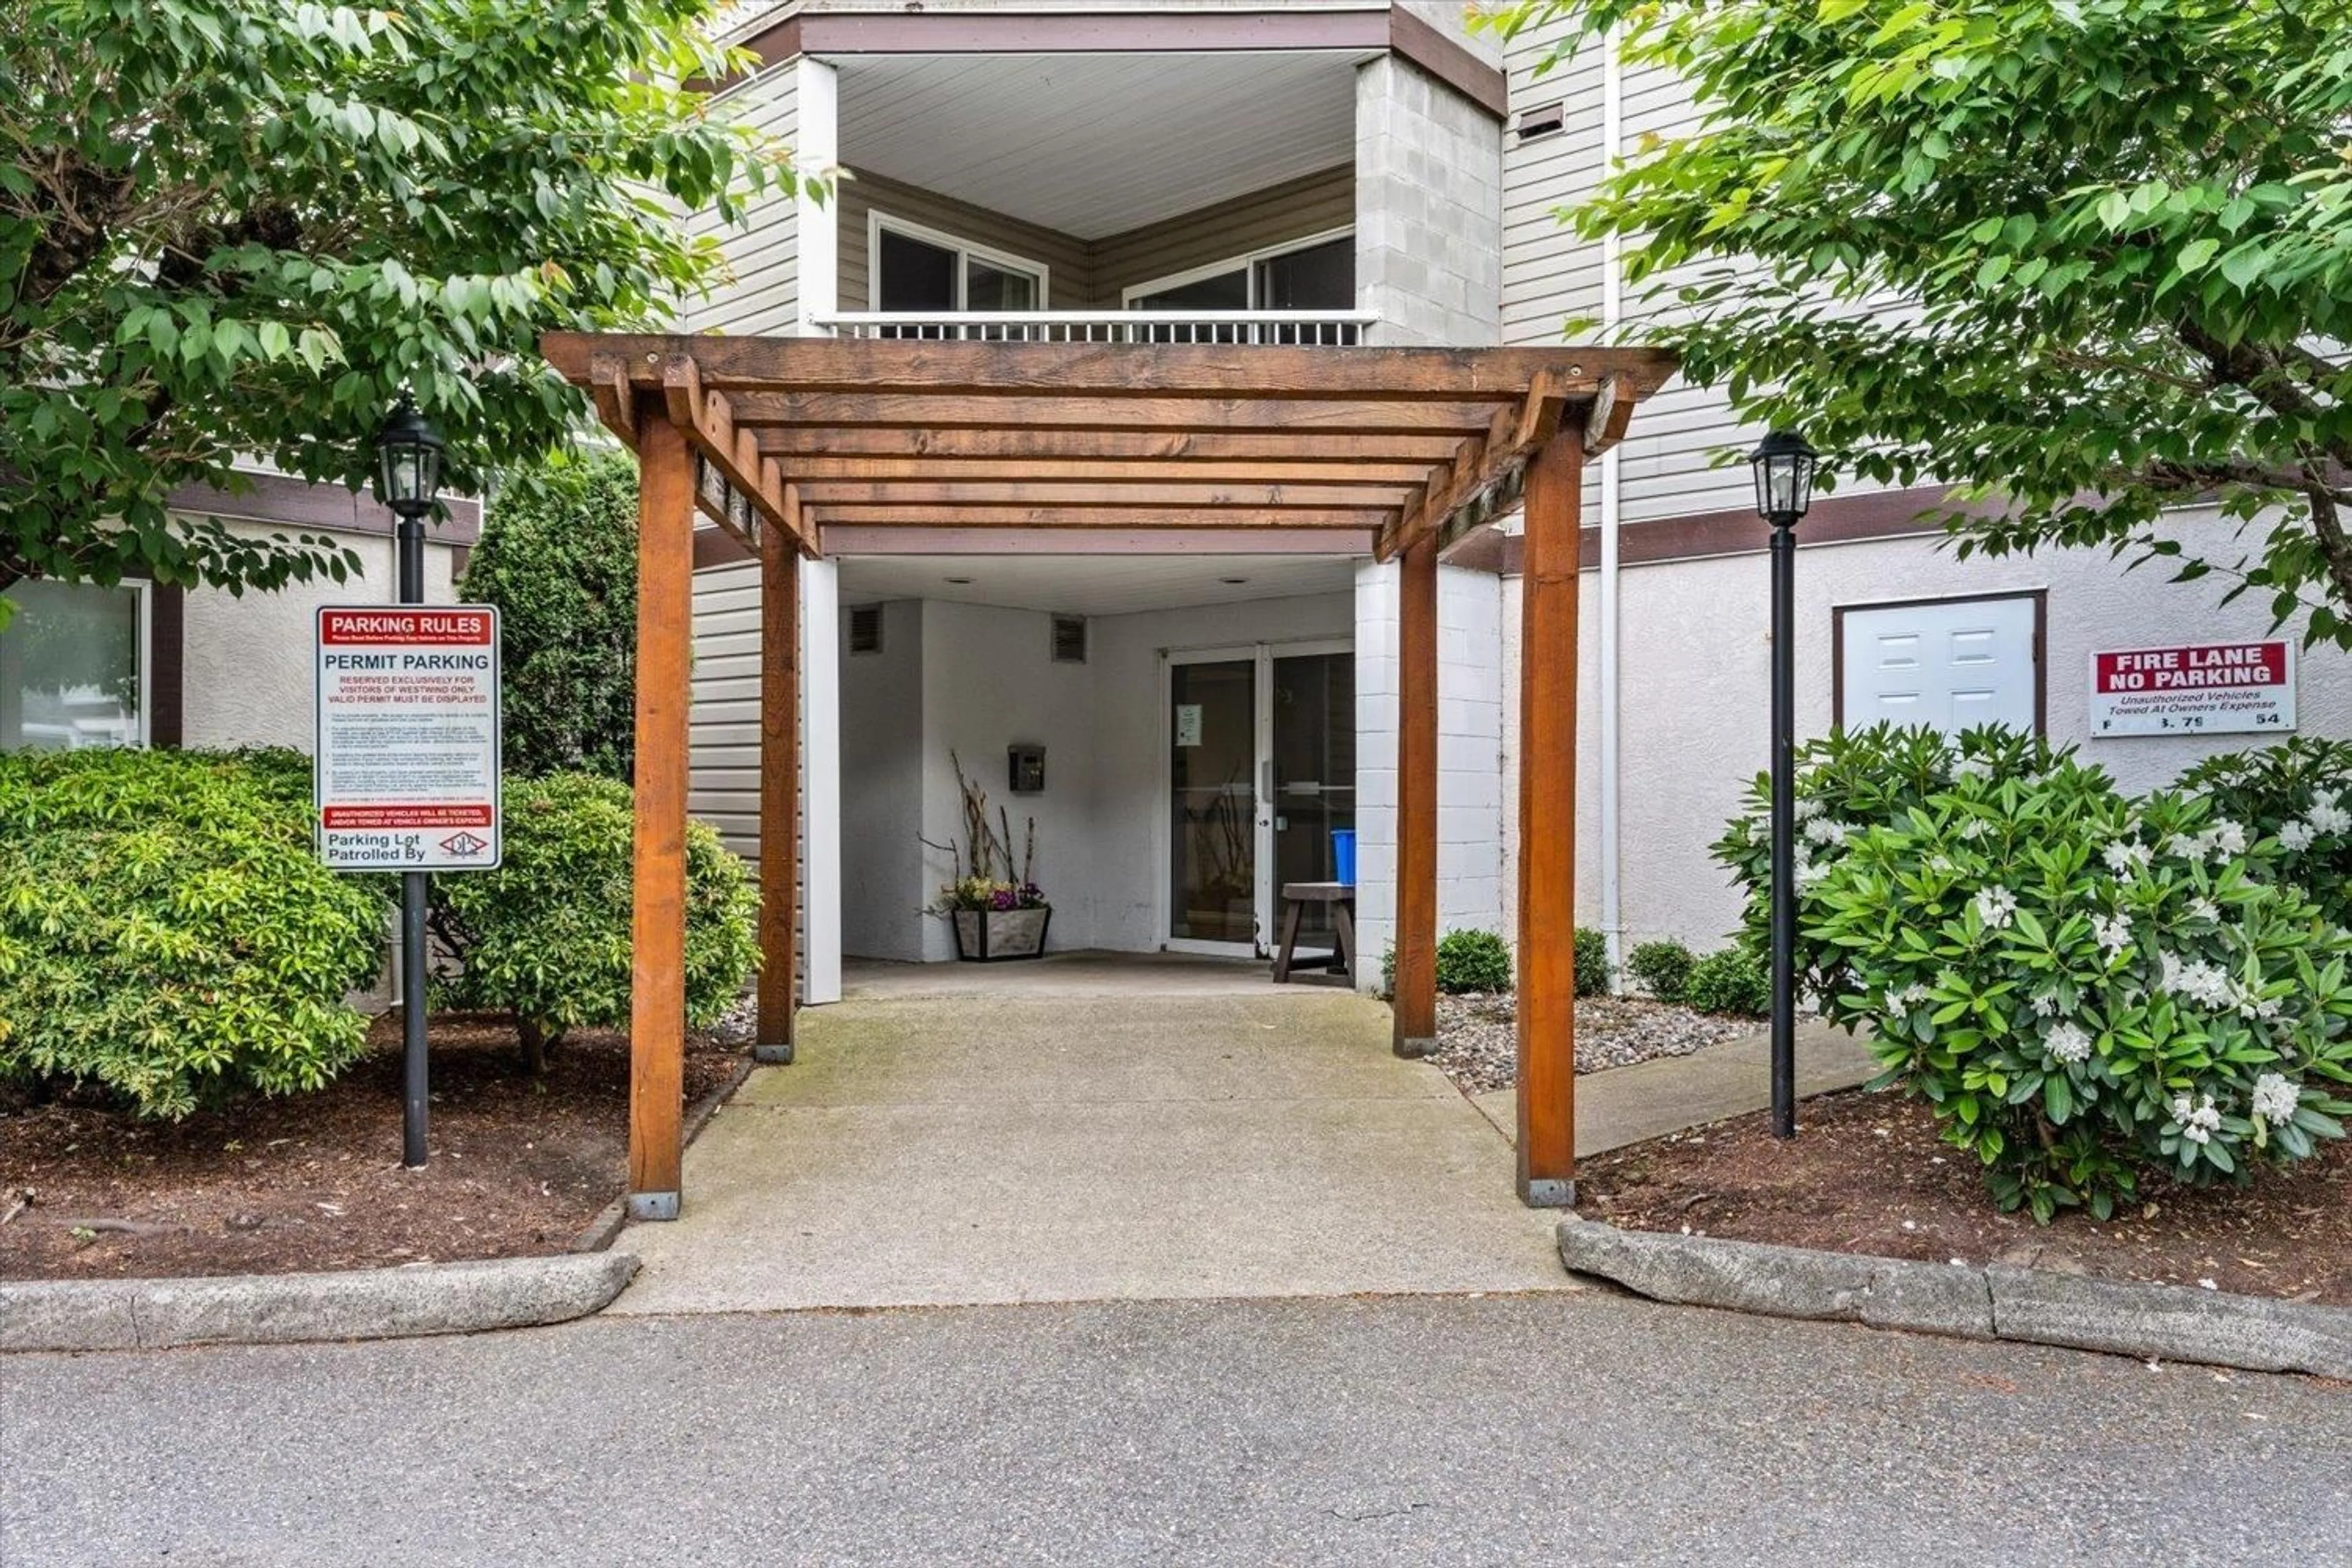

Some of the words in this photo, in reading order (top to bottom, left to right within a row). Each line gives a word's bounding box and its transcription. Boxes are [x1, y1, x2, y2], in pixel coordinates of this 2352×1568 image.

[332, 617, 415, 633] PARKING
[420, 617, 481, 633] RULES
[325, 655, 397, 669] PERMIT
[404, 655, 488, 669] PARKING
[2117, 654, 2179, 671] FIRE
[2190, 647, 2263, 667] LANE
[2109, 673, 2144, 690] NO
[2155, 666, 2271, 687] PARKING
[421, 695, 434, 703] BE
[436, 695, 488, 703] DISPLAYED
[2120, 693, 2204, 705] Unauthorized
[2207, 691, 2261, 701] Vehicles
[2109, 706, 2149, 715] Towed
[2150, 704, 2166, 713] At
[2168, 704, 2216, 712] Owners
[2220, 701, 2276, 712] Expense
[328, 834, 390, 847] Parking
[395, 834, 420, 846] Lot
[329, 848, 399, 860] Patrolled
[405, 848, 426, 861] By
